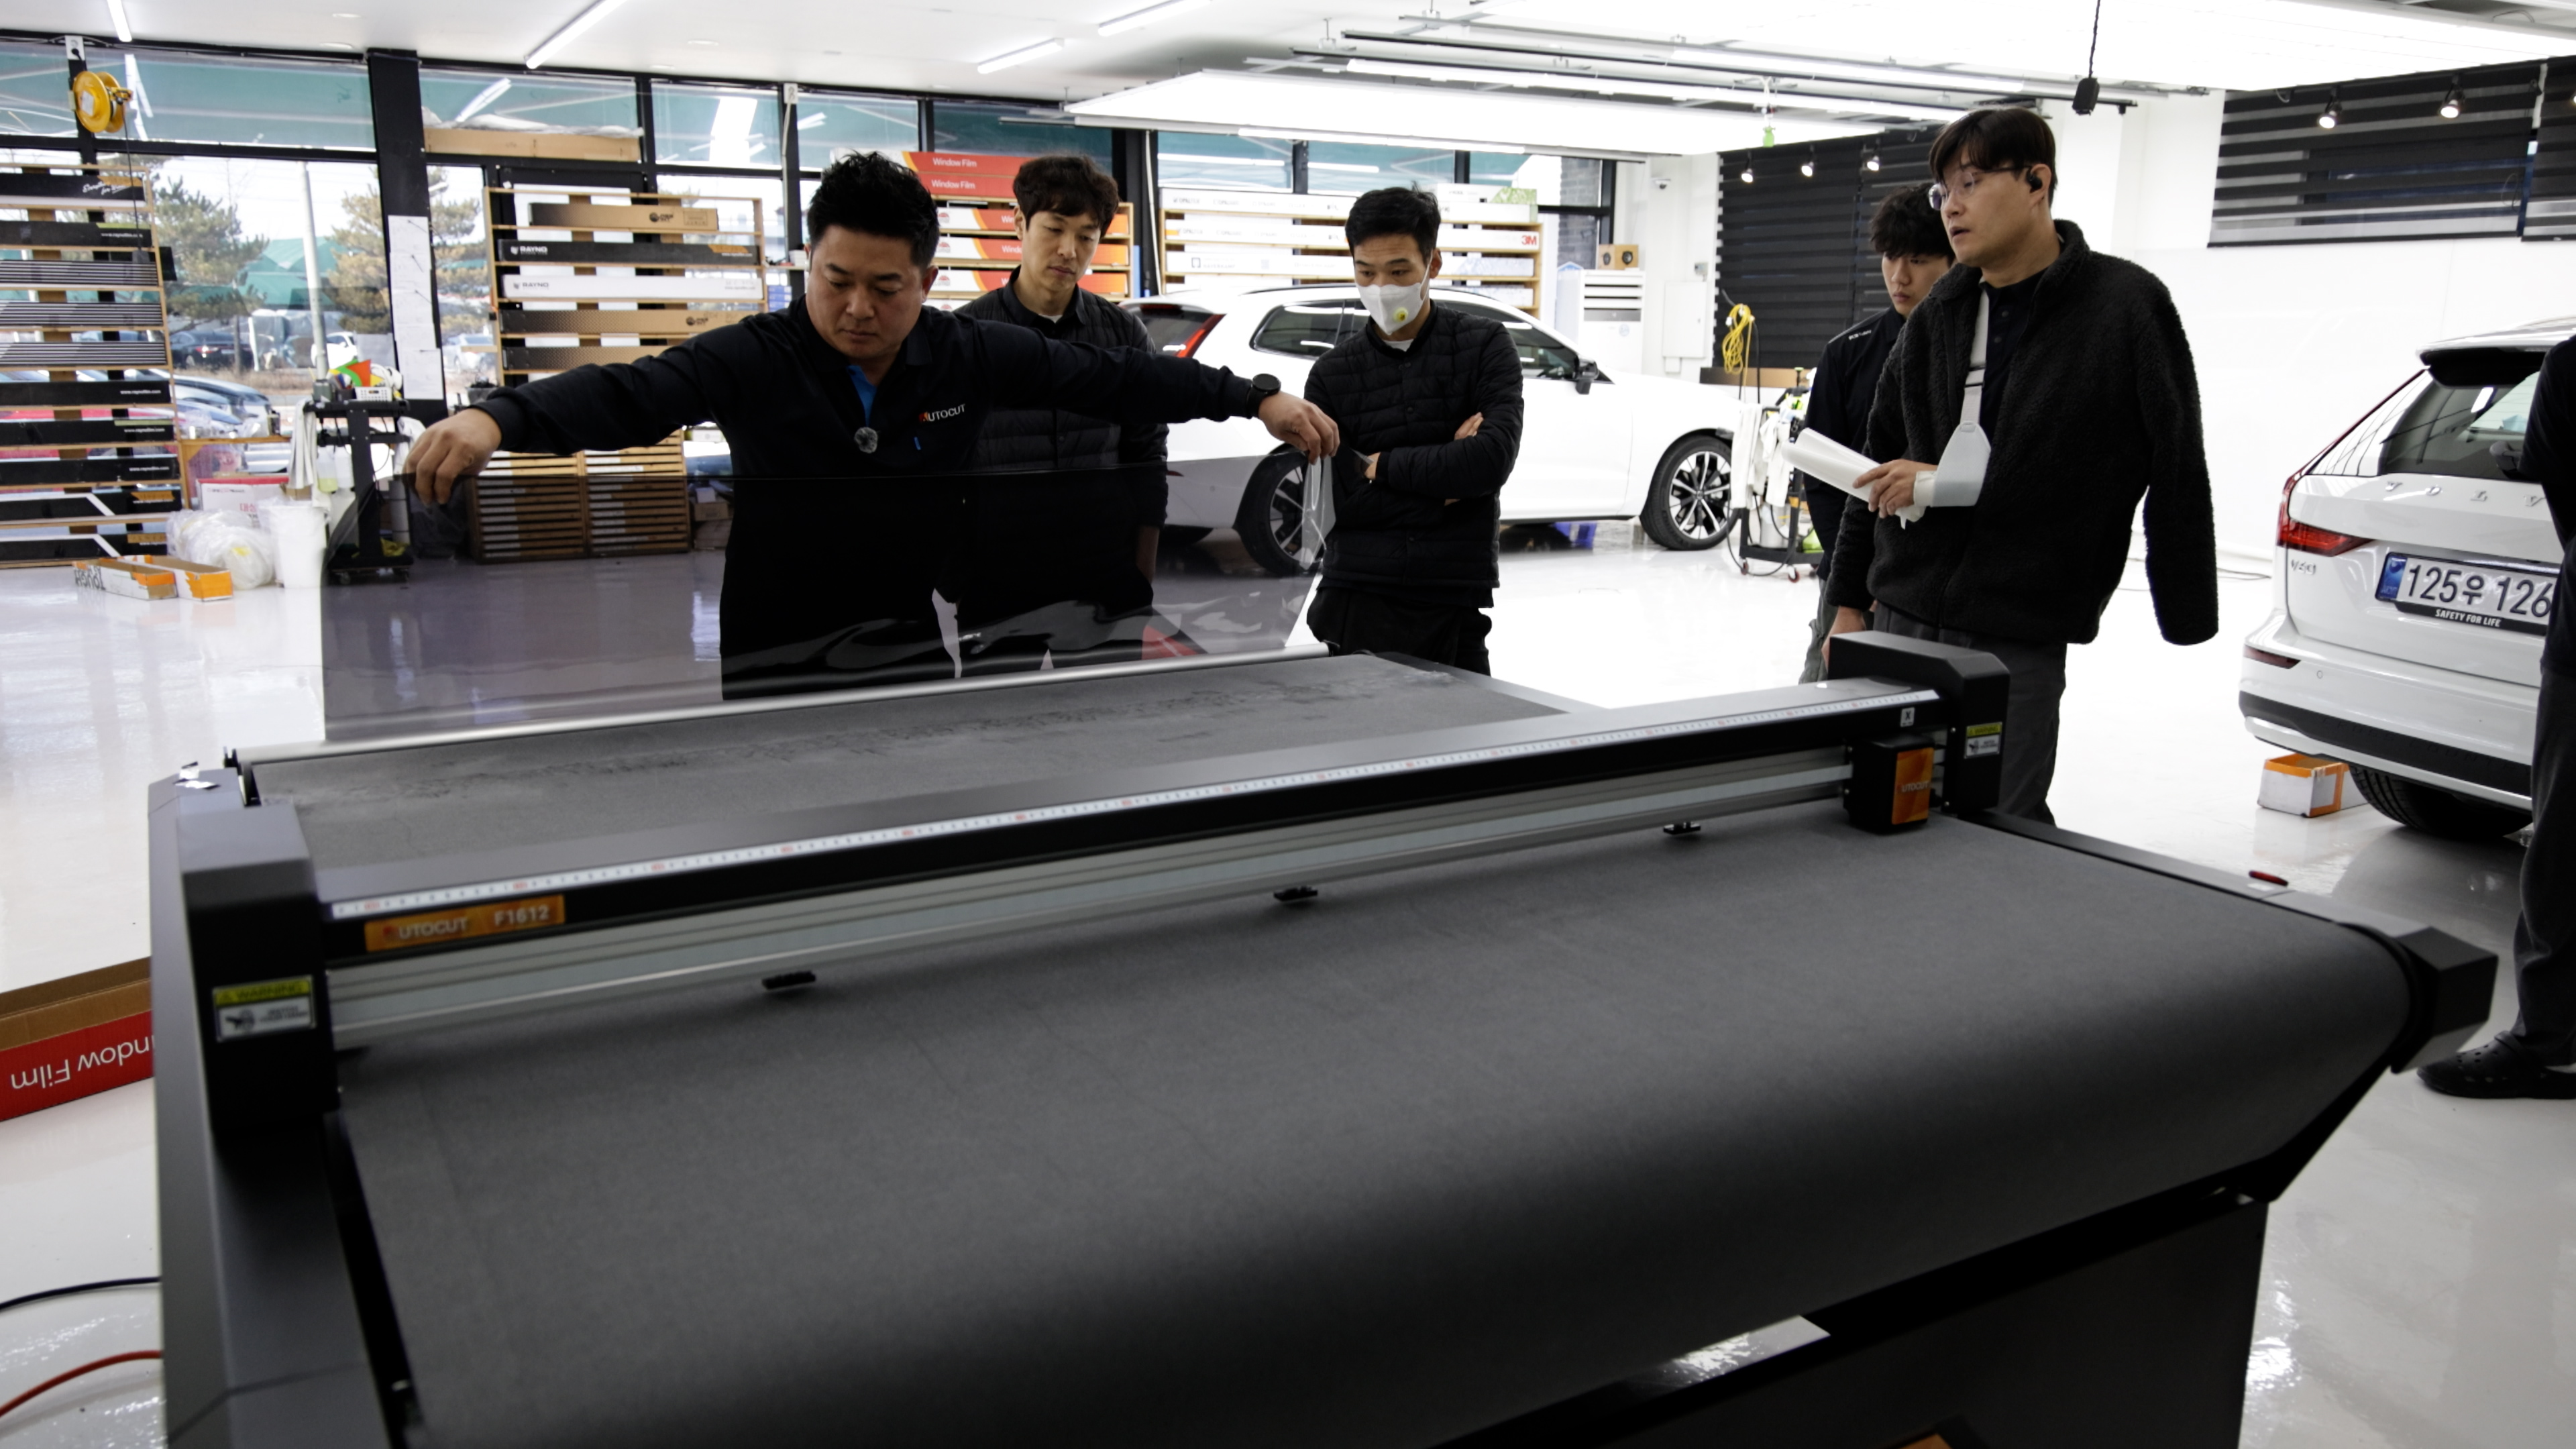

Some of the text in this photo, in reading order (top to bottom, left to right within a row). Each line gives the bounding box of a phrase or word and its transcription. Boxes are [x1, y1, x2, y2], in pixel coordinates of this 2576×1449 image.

[932, 158, 977, 167] Window Film
[931, 179, 960, 188] Window
[1001, 215, 1014, 223] Win
[1521, 235, 1537, 245] 3M
[1002, 246, 1022, 254] Windo
[2385, 481, 2546, 506] VOLV
[74, 570, 106, 591] TOUGH
[2408, 564, 2553, 618] 125우 126
[2434, 608, 2502, 627] SAFETY FOR LIFE
[1905, 710, 1911, 720] X
[494, 904, 550, 927] F1612
[11, 1034, 155, 1089] ndow Film
